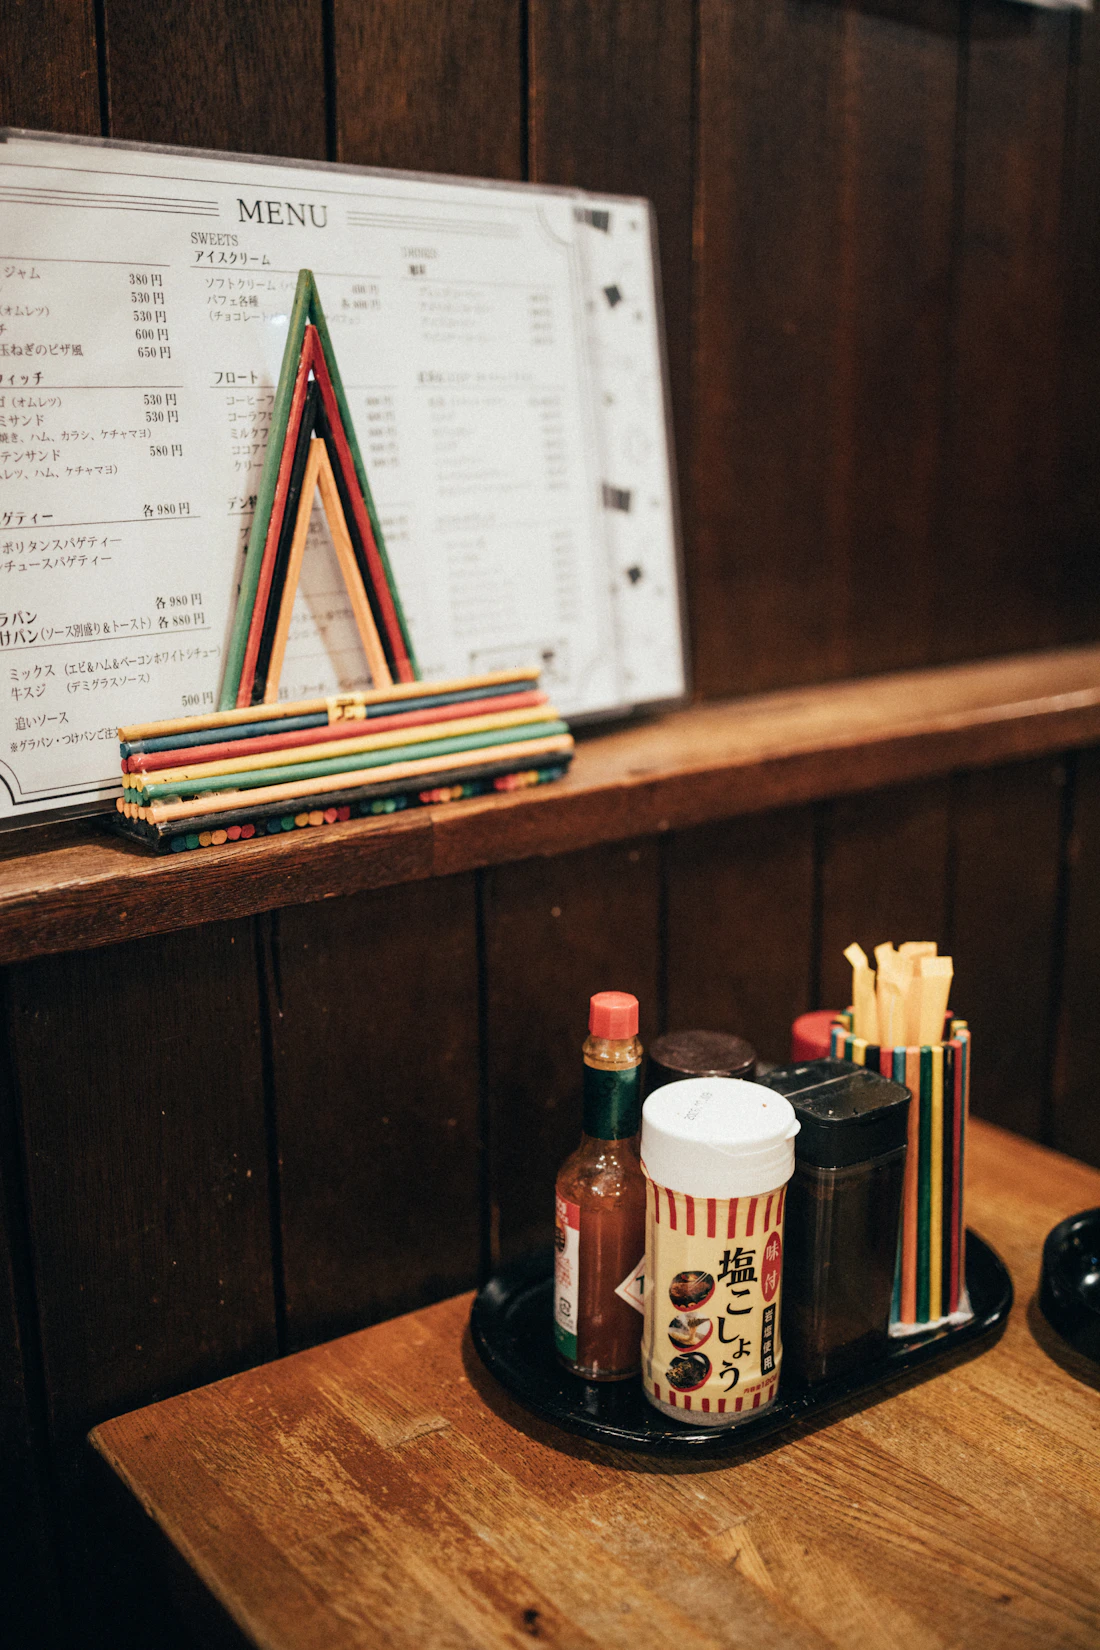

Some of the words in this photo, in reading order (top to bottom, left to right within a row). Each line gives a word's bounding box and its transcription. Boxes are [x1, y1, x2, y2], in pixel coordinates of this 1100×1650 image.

[236, 198, 328, 228] MENU
[190, 232, 239, 247] SWEETS
[194, 250, 271, 266] アイスクリーム
[4, 265, 41, 279] ジャム
[129, 273, 163, 287] 380円
[131, 292, 165, 304] 530円
[133, 310, 167, 323] 530円
[135, 328, 169, 341] 600円
[0, 343, 84, 356] 玉ねぎのピザ風
[138, 346, 172, 359] 650円
[214, 371, 259, 384] フロート
[143, 393, 177, 406] 530円
[145, 410, 179, 423] 530円
[149, 443, 183, 457] 580円
[0, 512, 54, 526] ゲティー
[2, 536, 122, 555] ポリタンスパゲティー
[0, 555, 112, 573] チュースパゲティー
[9, 663, 56, 682] ミックス
[11, 683, 47, 702] 牛スジ
[14, 711, 70, 732] 追いソース
[181, 690, 215, 708] 500円
[764, 1240, 779, 1294] 味付
[717, 1247, 758, 1393] 塩こしょう
